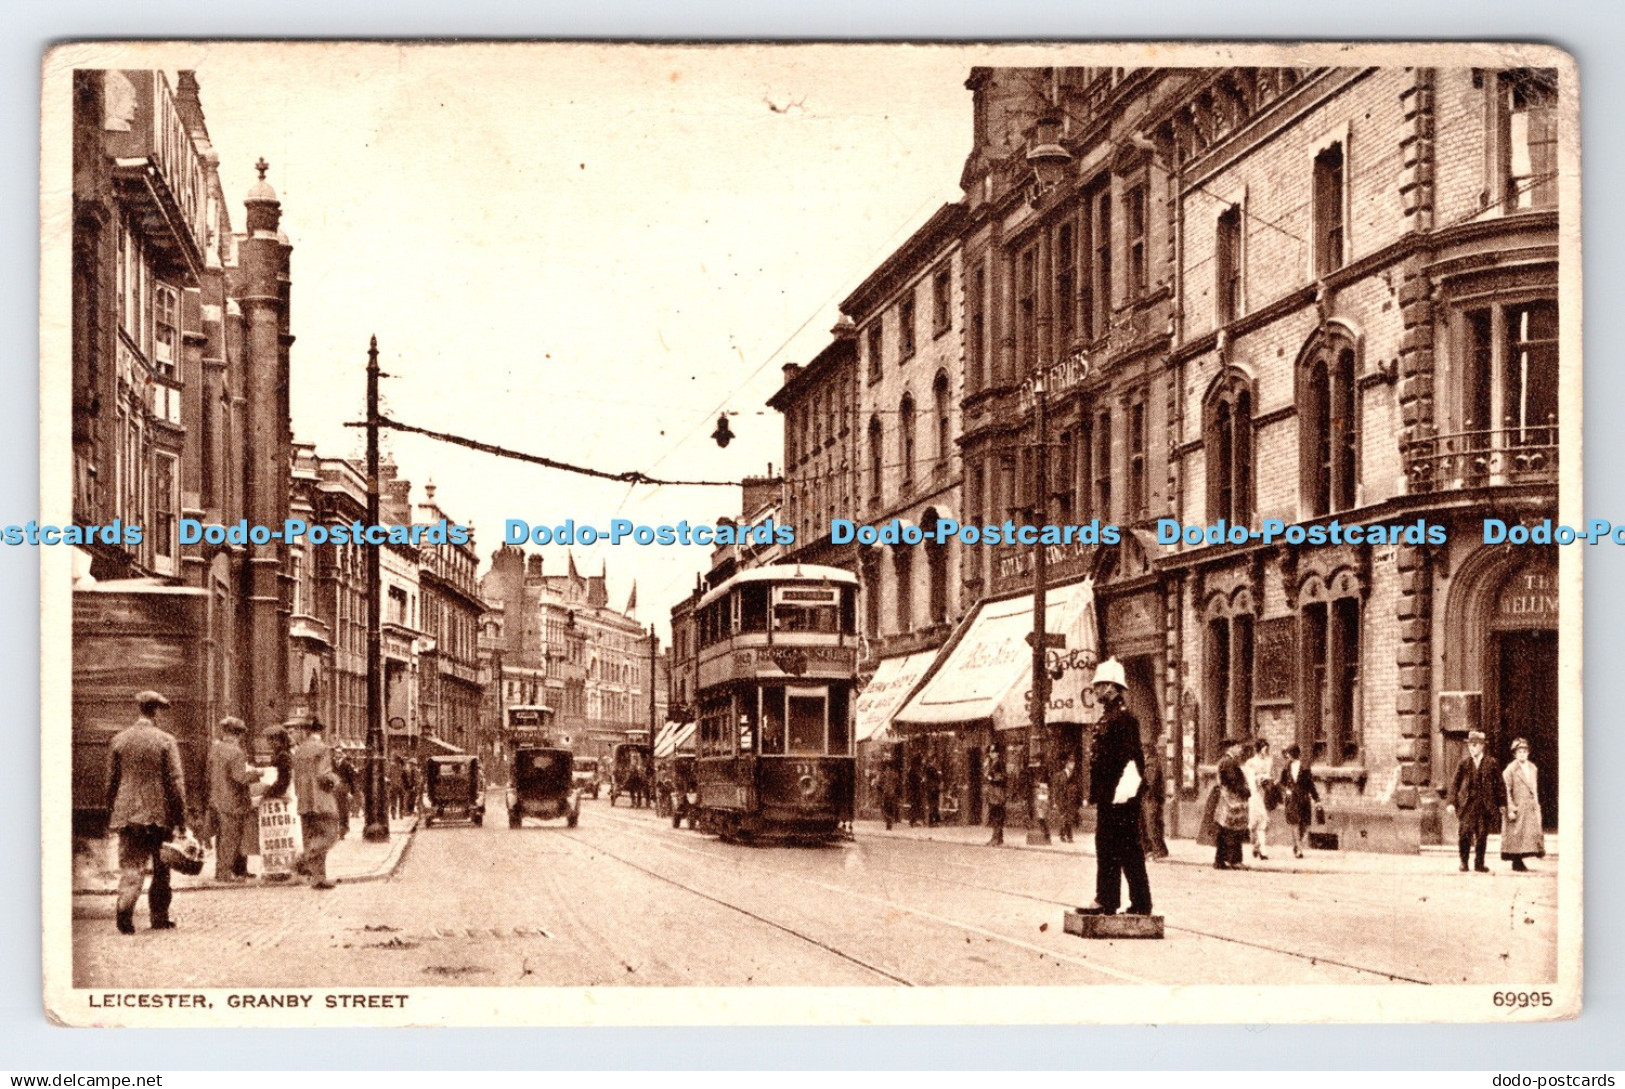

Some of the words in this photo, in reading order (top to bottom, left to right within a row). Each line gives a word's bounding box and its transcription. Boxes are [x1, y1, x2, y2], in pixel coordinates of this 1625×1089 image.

[227, 994, 313, 1008] GRANBY
[325, 994, 409, 1008] STREET
[1493, 991, 1553, 1008] 69995
